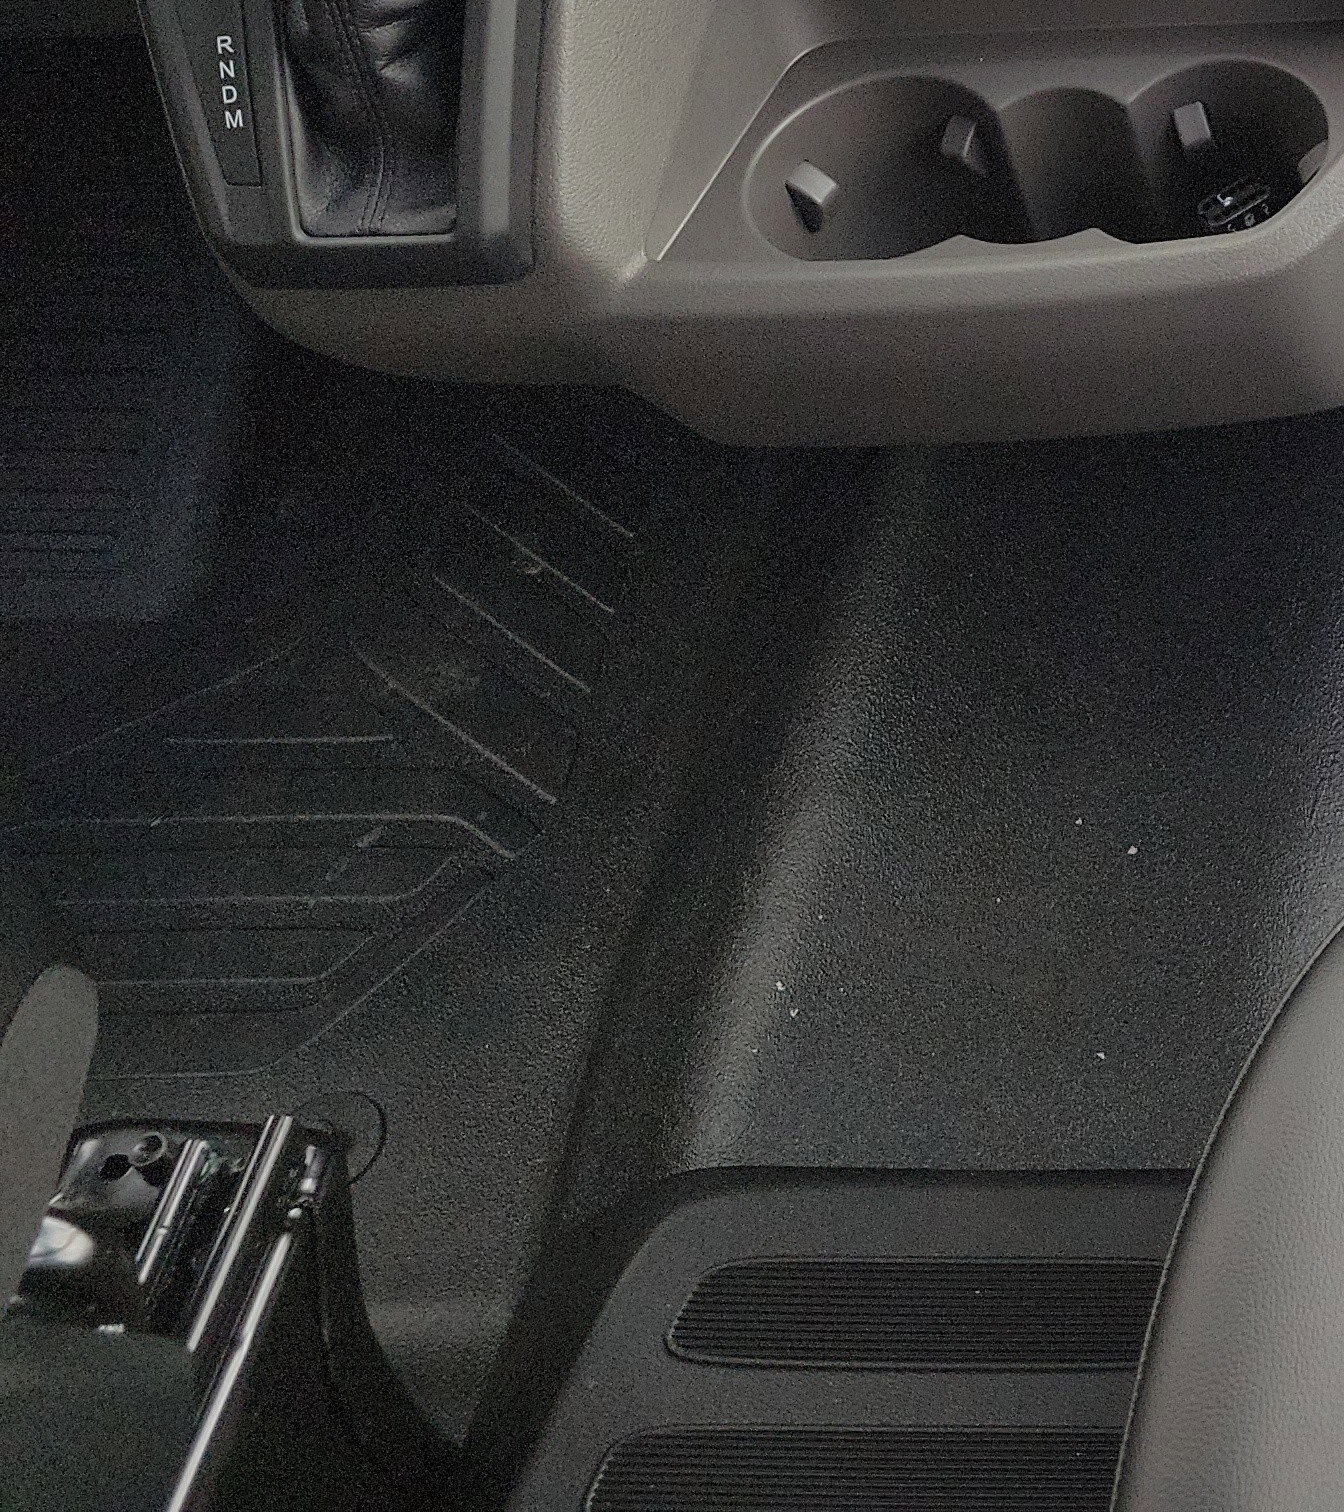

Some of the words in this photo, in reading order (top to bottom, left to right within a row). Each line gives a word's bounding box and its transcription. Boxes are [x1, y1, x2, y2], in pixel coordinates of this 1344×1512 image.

[216, 35, 234, 54] R
[219, 59, 235, 79] N
[221, 85, 238, 104] D
[224, 109, 244, 129] M
